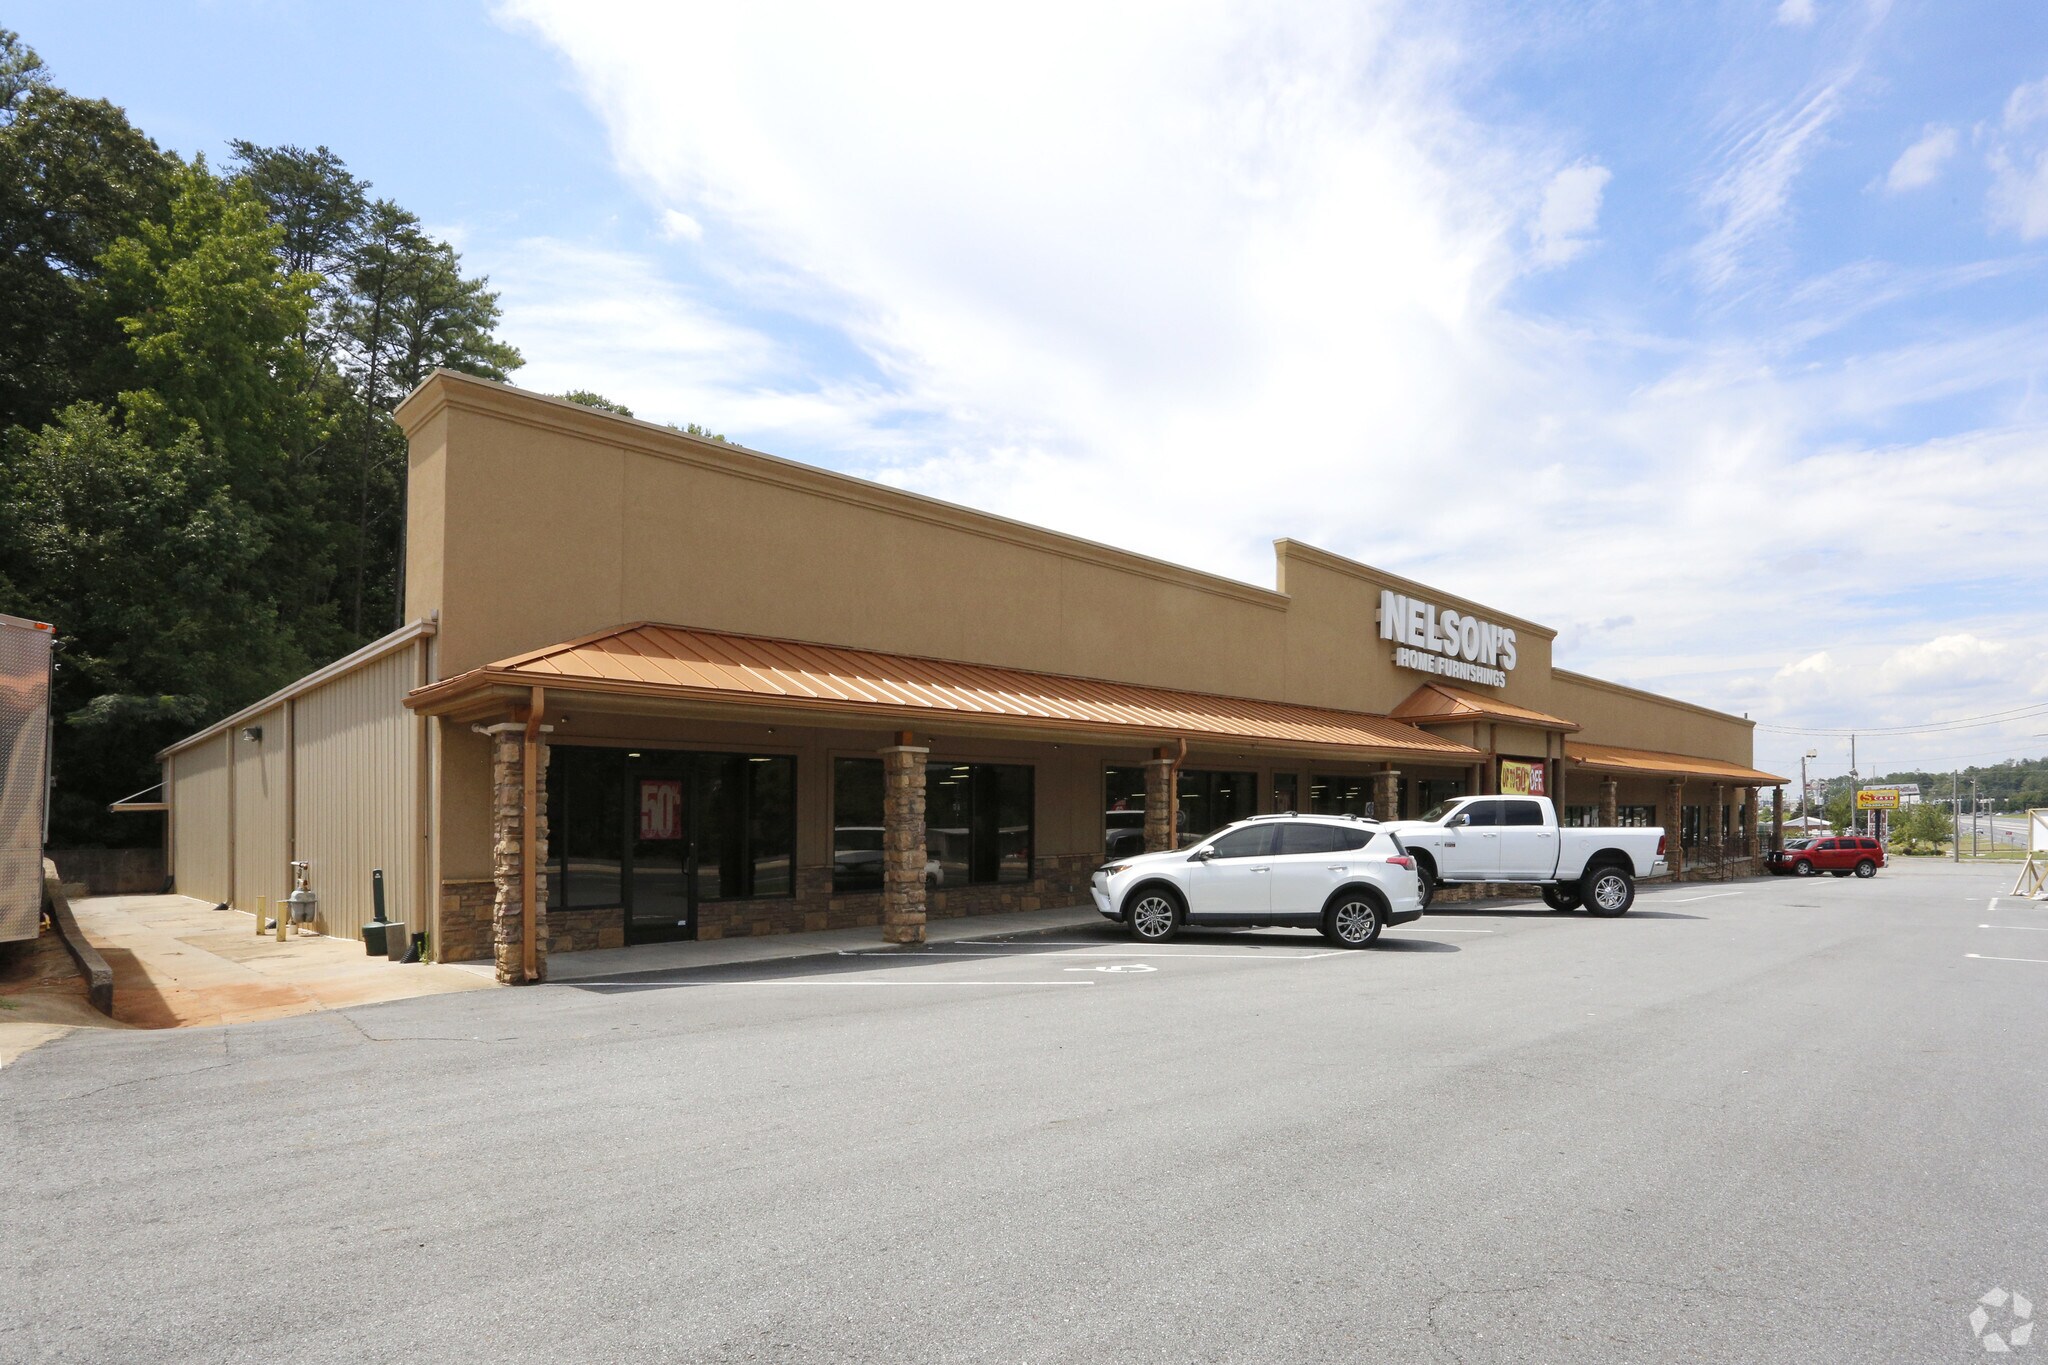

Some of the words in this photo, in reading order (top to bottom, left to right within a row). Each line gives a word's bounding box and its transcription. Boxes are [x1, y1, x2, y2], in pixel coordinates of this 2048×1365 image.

[1380, 590, 1516, 671] NELSON'S
[1396, 647, 1434, 674] HOME
[1435, 656, 1506, 688] FURNISHINGS
[1529, 768, 1543, 791] OFF
